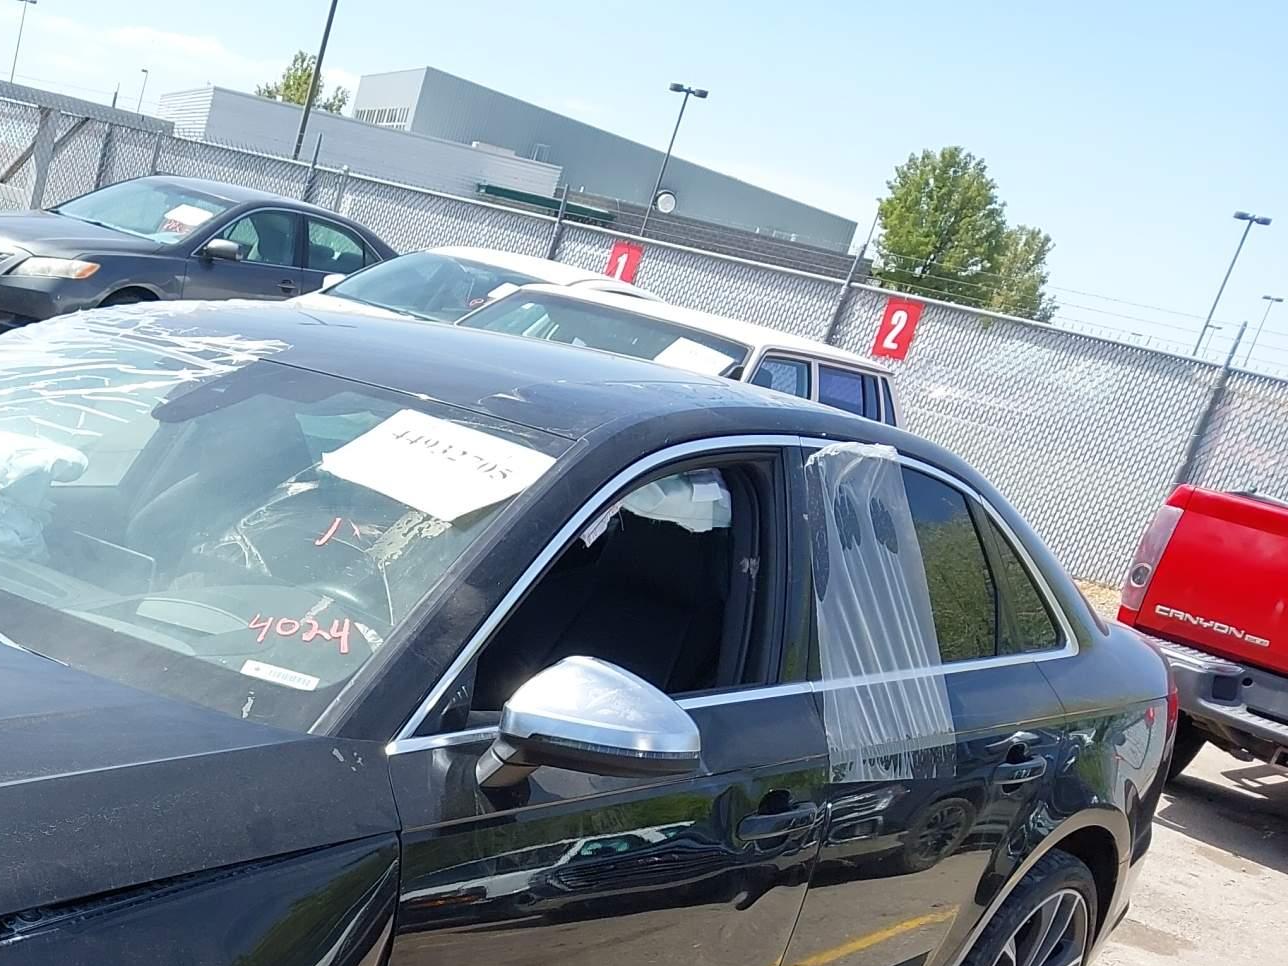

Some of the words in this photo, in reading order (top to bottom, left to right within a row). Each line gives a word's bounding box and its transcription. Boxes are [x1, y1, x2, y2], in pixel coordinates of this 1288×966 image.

[614, 253, 629, 281] 1
[882, 309, 908, 350] 2
[248, 613, 351, 655] 4024
[1154, 604, 1245, 639] CANYON
